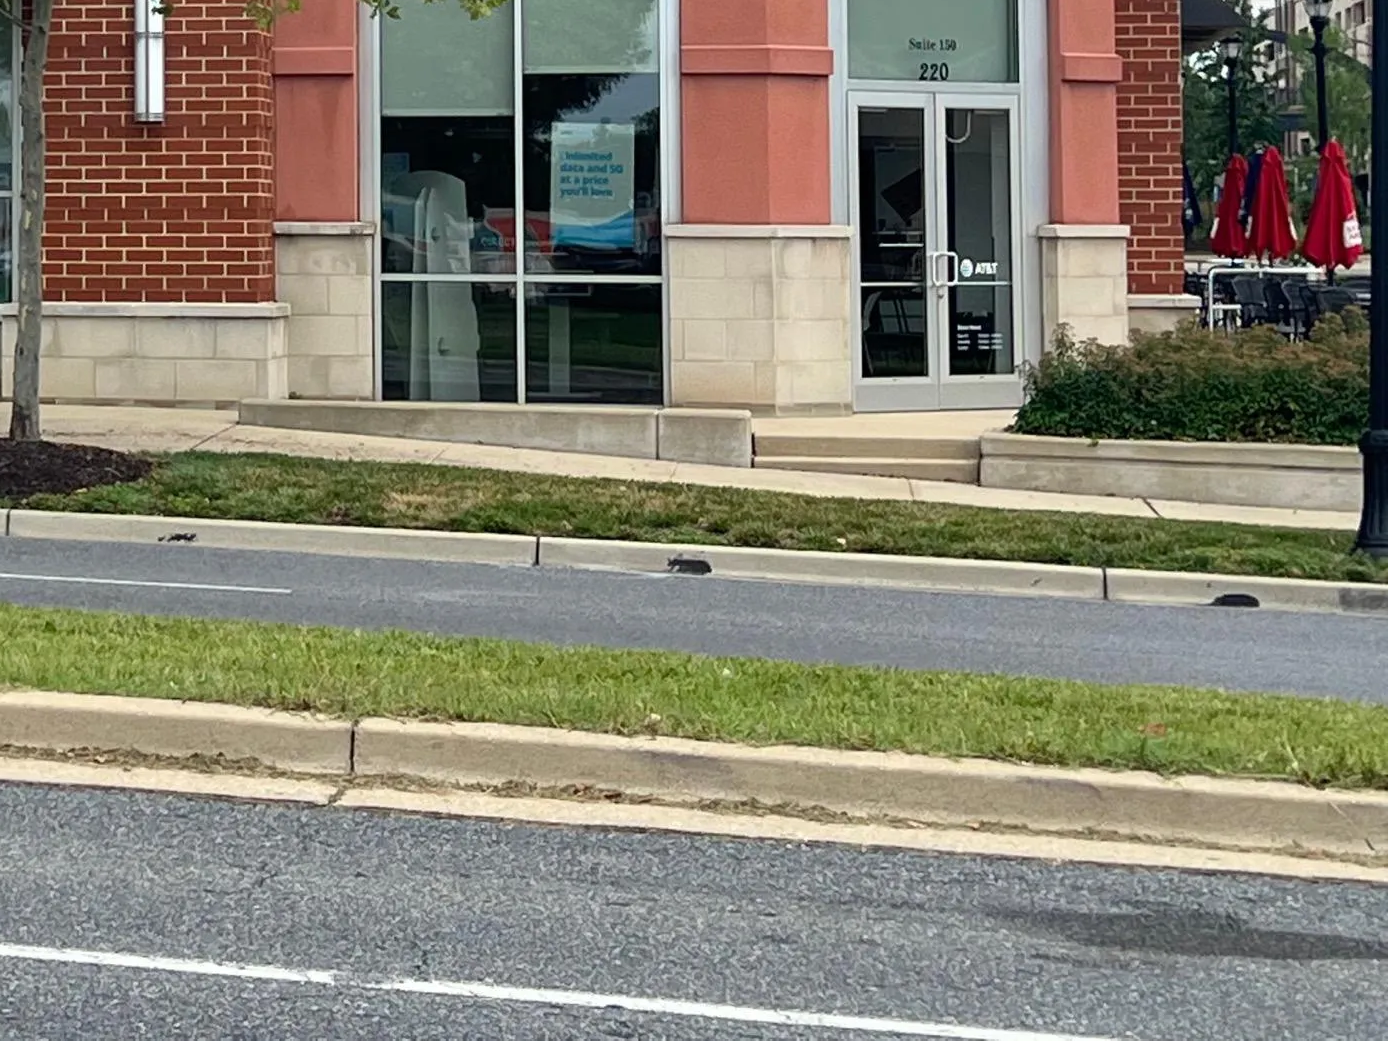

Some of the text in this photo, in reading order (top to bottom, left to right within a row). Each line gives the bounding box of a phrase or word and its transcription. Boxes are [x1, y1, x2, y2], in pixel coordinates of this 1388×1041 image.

[908, 38, 937, 50] Suite
[919, 62, 949, 80] 220
[560, 163, 584, 172] data
[587, 163, 608, 173] and
[583, 175, 609, 186] price
[975, 263, 998, 274] AT&T
